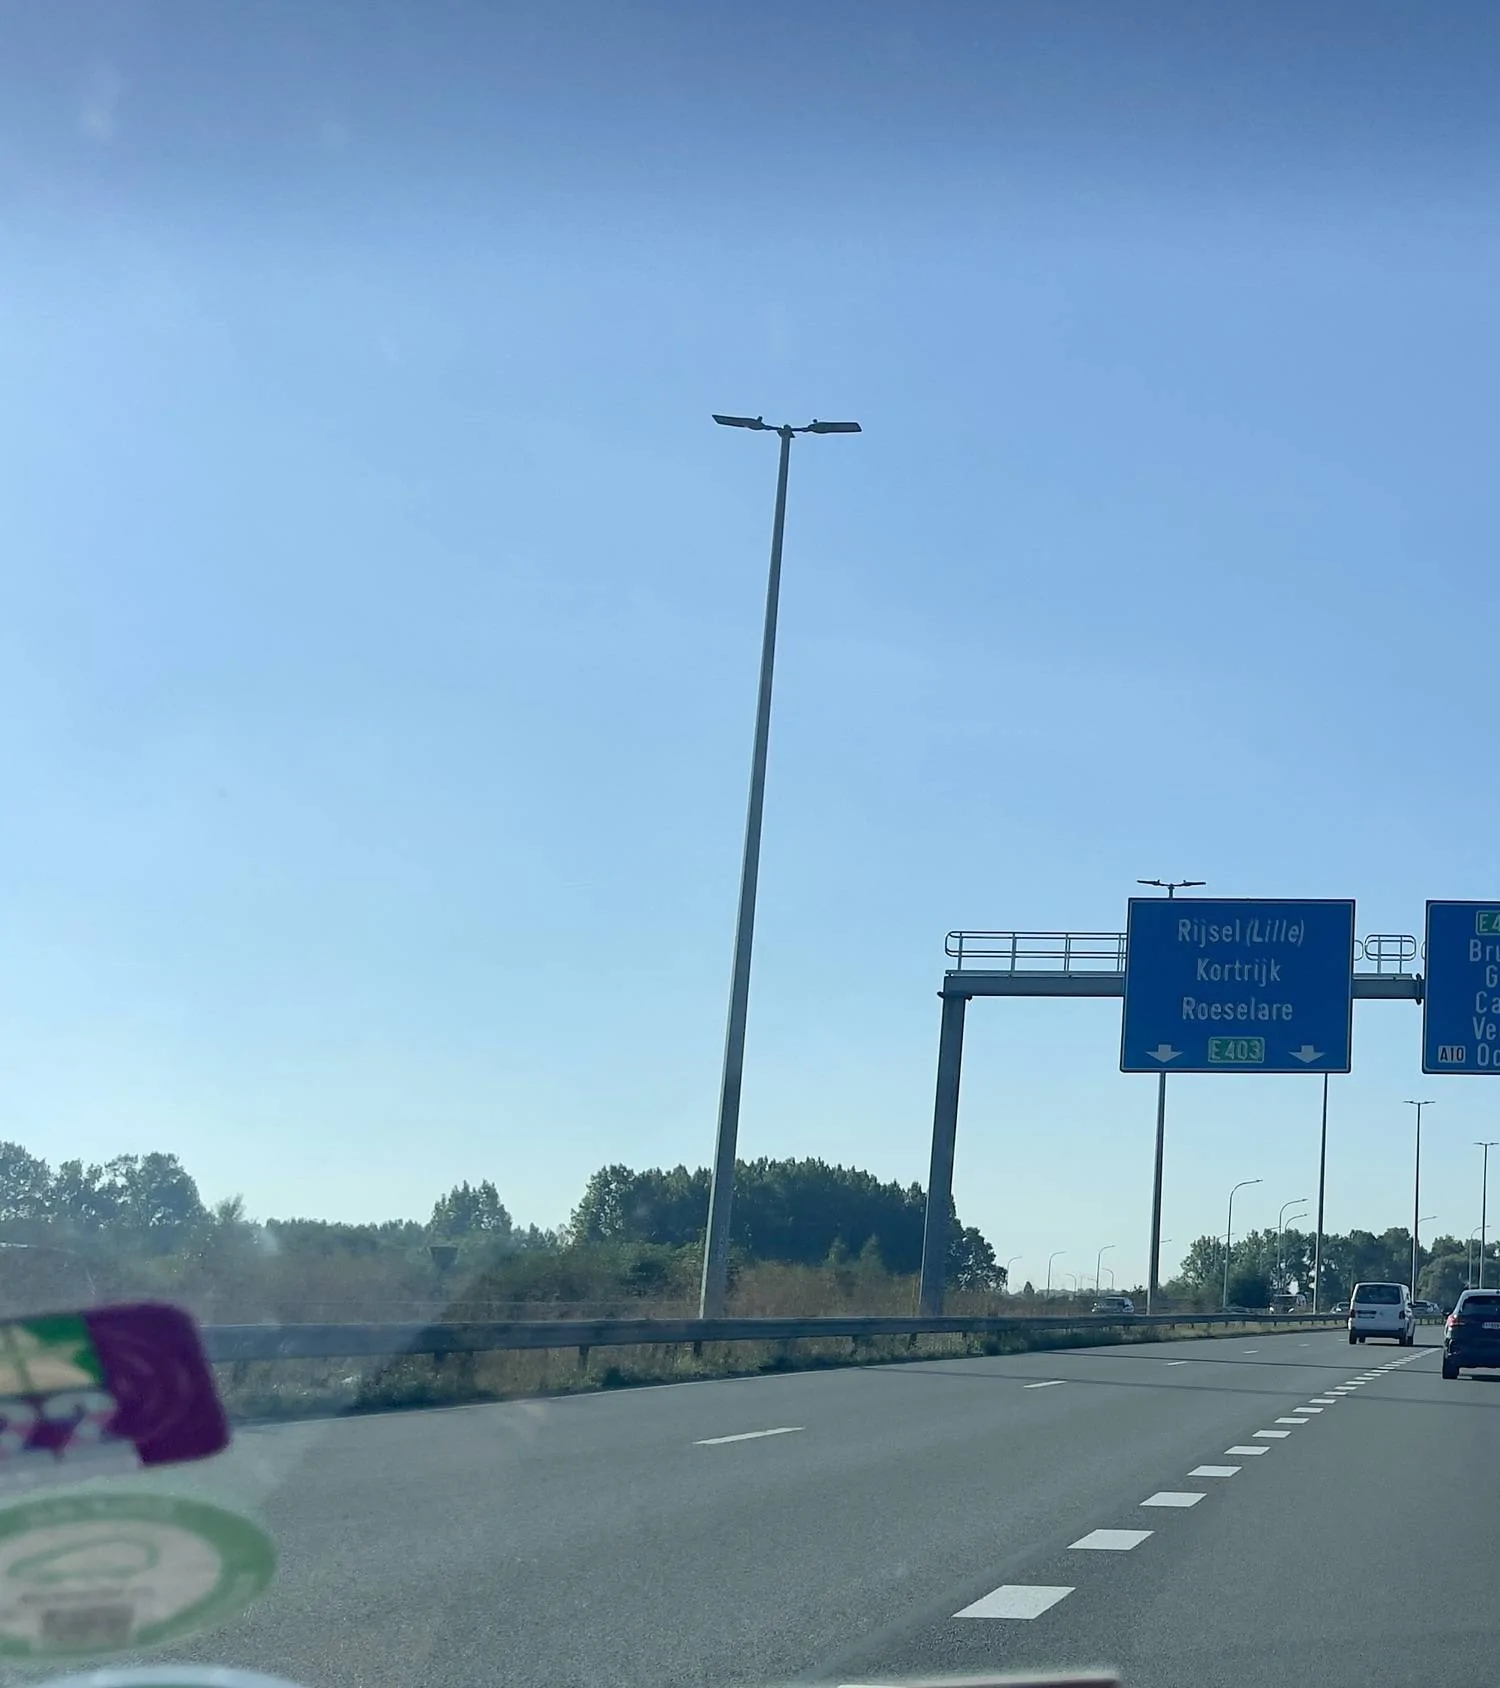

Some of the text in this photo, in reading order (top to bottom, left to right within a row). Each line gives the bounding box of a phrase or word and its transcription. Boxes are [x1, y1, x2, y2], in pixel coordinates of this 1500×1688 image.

[1178, 919, 1305, 948] Rijsel (Lille)
[1196, 958, 1281, 987] Kortrijk
[1182, 996, 1293, 1021] Roeselare
[1440, 1047, 1464, 1061] A10
